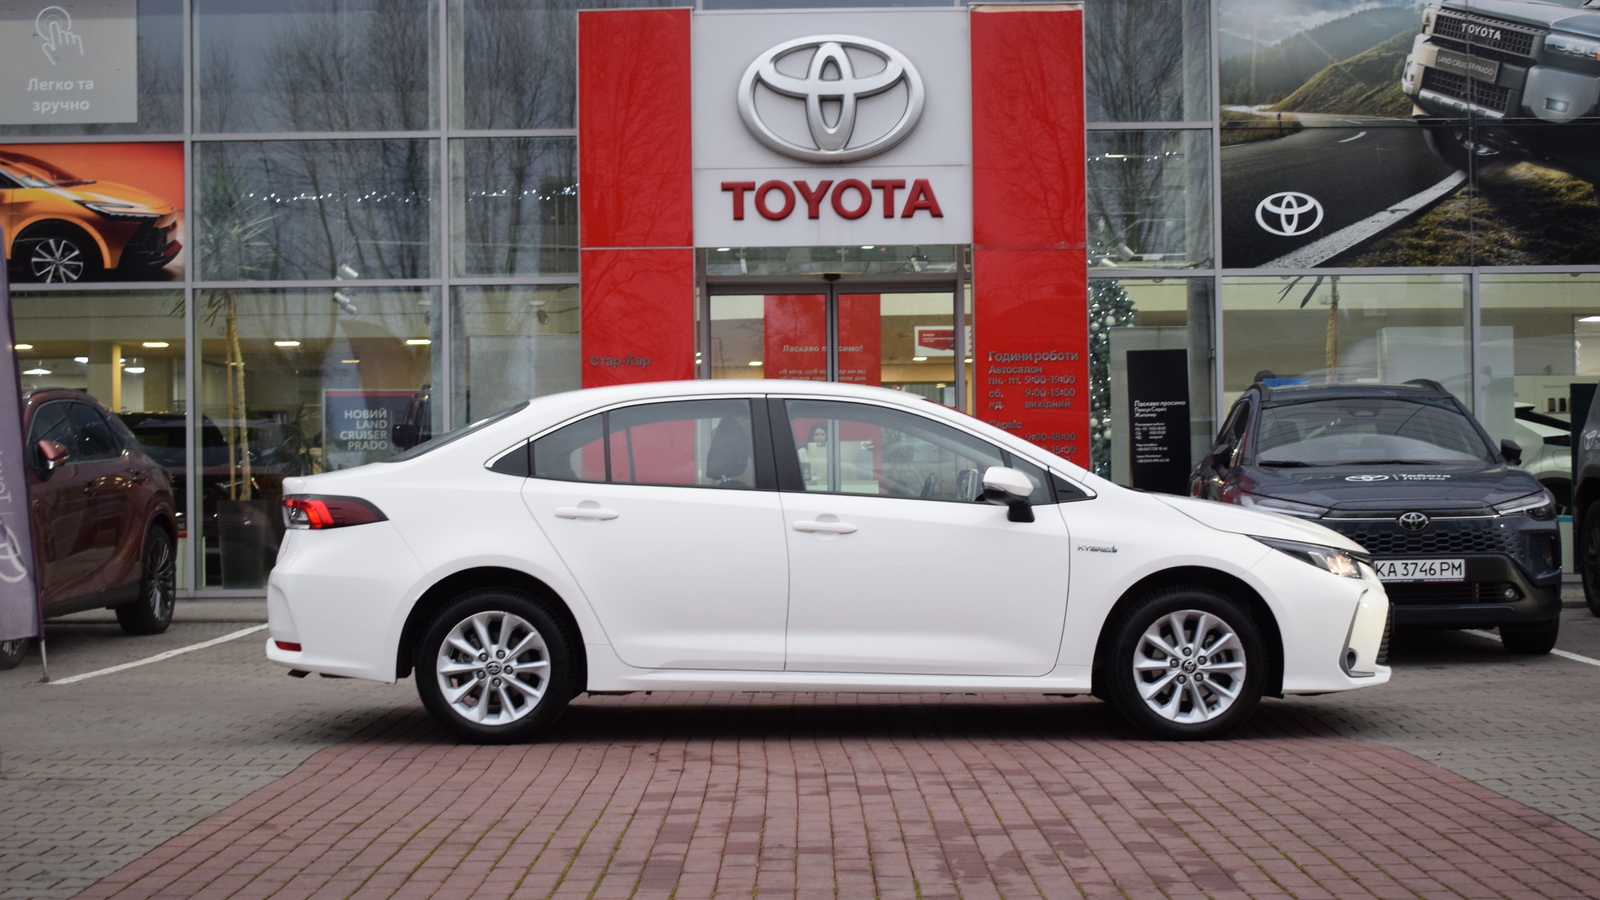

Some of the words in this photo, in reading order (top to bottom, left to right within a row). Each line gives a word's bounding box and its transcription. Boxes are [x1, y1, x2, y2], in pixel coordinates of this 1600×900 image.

[1461, 23, 1501, 40] TOYOTA
[27, 78, 74, 92] Легко
[77, 79, 94, 91] та
[32, 101, 90, 114] зручно
[721, 179, 944, 221] TOYOTA
[782, 345, 820, 353] Ласкаво
[822, 345, 864, 353] псимо!
[589, 355, 651, 368] Стар-Кар
[988, 351, 1033, 363] Години
[1034, 350, 1079, 364] роботи
[988, 365, 1043, 374] Автосалон
[1024, 375, 1076, 384] 9:00-19:00
[988, 388, 1004, 398] сб.
[1025, 388, 1076, 397] 9:00-15:00
[1025, 399, 1072, 409] вихідний
[344, 407, 387, 419] НОВИЙ
[356, 420, 387, 430] LAND
[340, 430, 387, 440] CRUISER
[347, 440, 388, 450] PRADO
[1375, 562, 1398, 577] KA
[1401, 562, 1437, 577] 3746
[1440, 561, 1462, 576] PM
